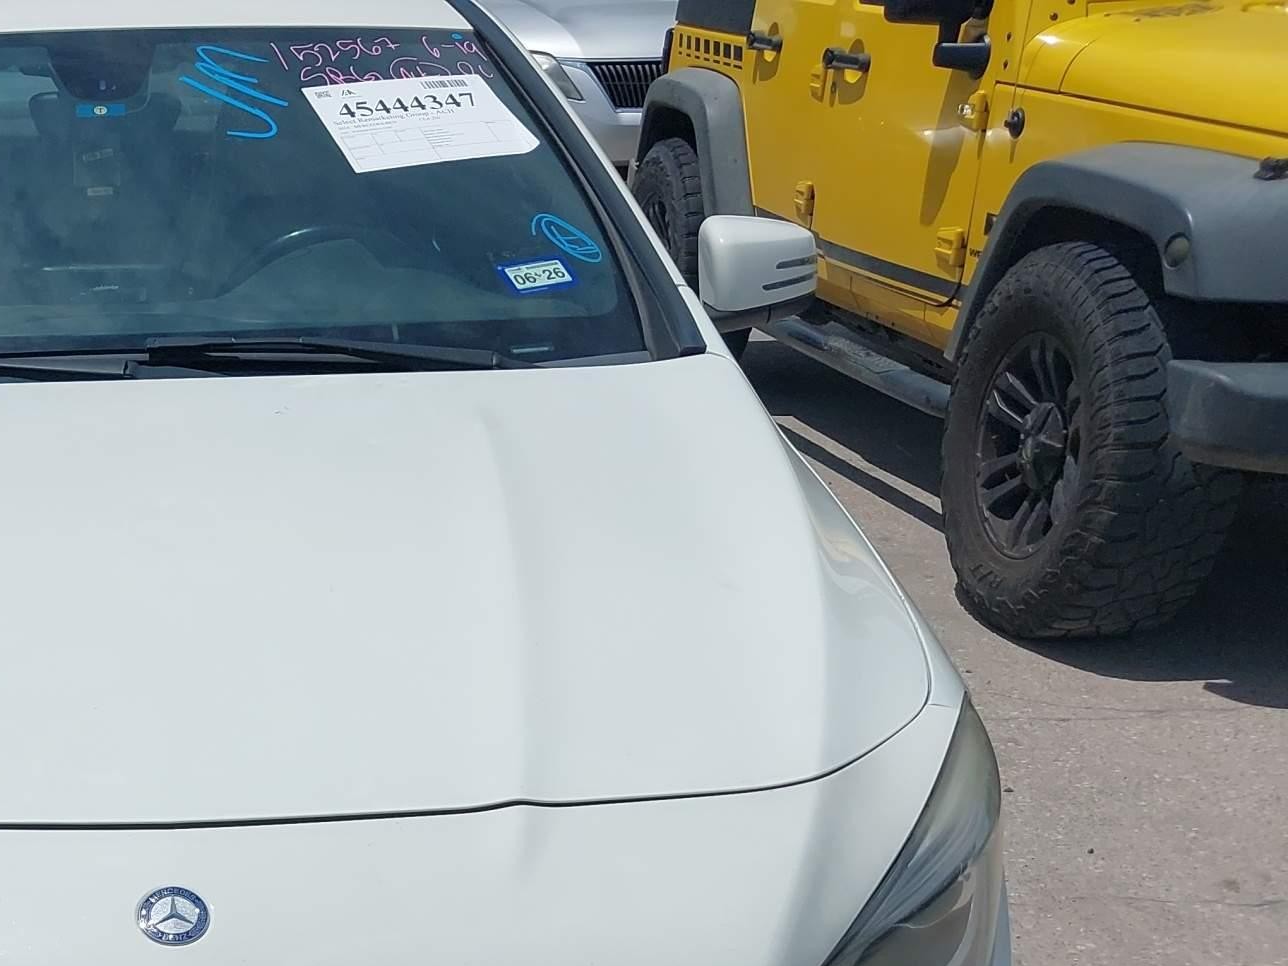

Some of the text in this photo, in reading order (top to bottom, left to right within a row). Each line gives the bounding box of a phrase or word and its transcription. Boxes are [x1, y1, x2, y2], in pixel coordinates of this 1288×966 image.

[338, 92, 475, 118] 45444347
[513, 271, 537, 286] 06
[542, 266, 566, 281] 26
